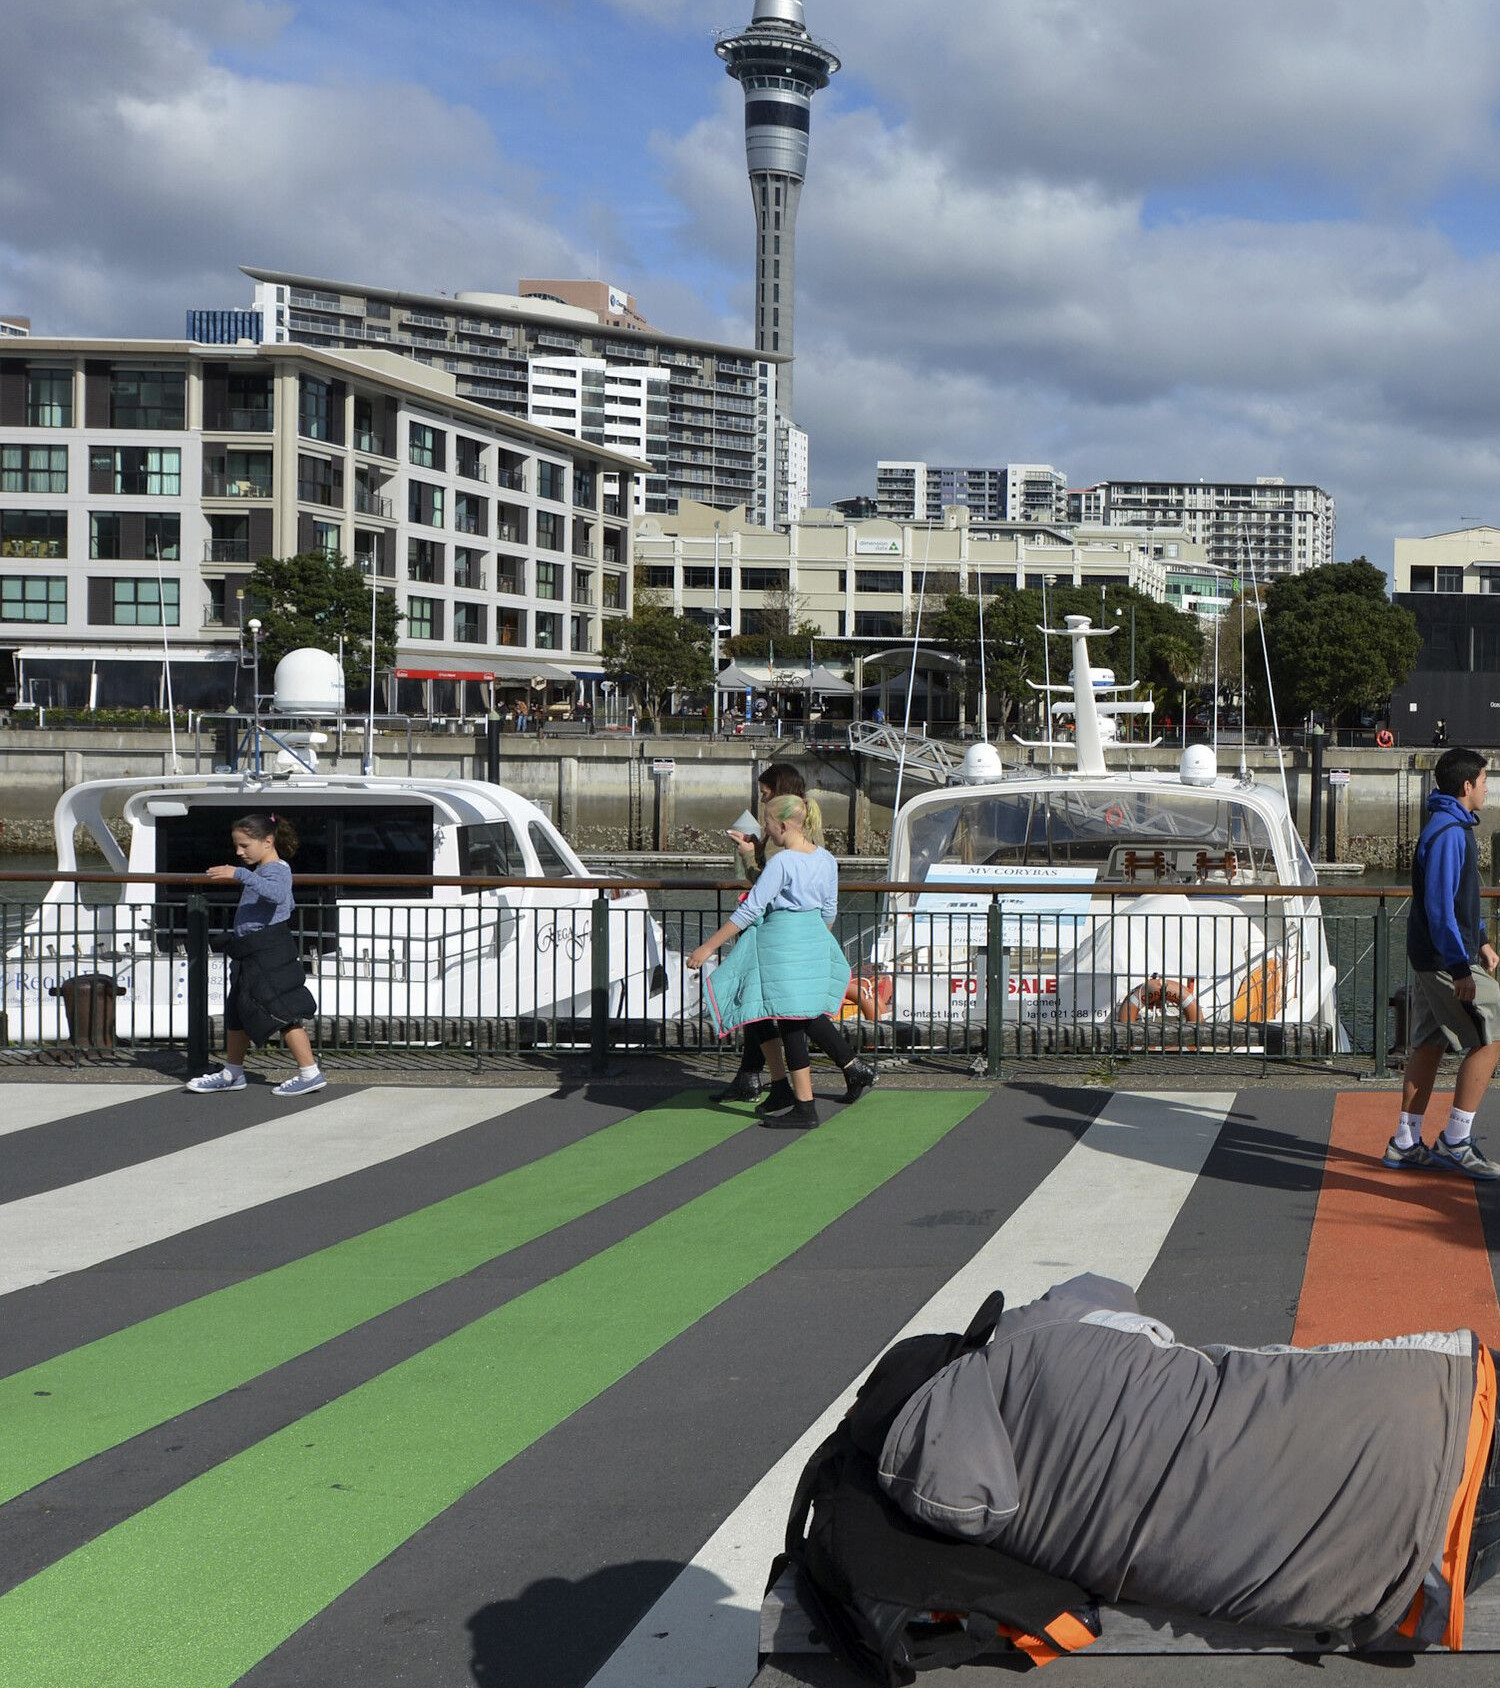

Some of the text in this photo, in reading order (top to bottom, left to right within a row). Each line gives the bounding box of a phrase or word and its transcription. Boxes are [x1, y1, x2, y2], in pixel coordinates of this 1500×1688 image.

[968, 867, 1058, 876] MV CORYBAS
[1008, 978, 1057, 994] SALE
[903, 1009, 942, 1018] Contact
